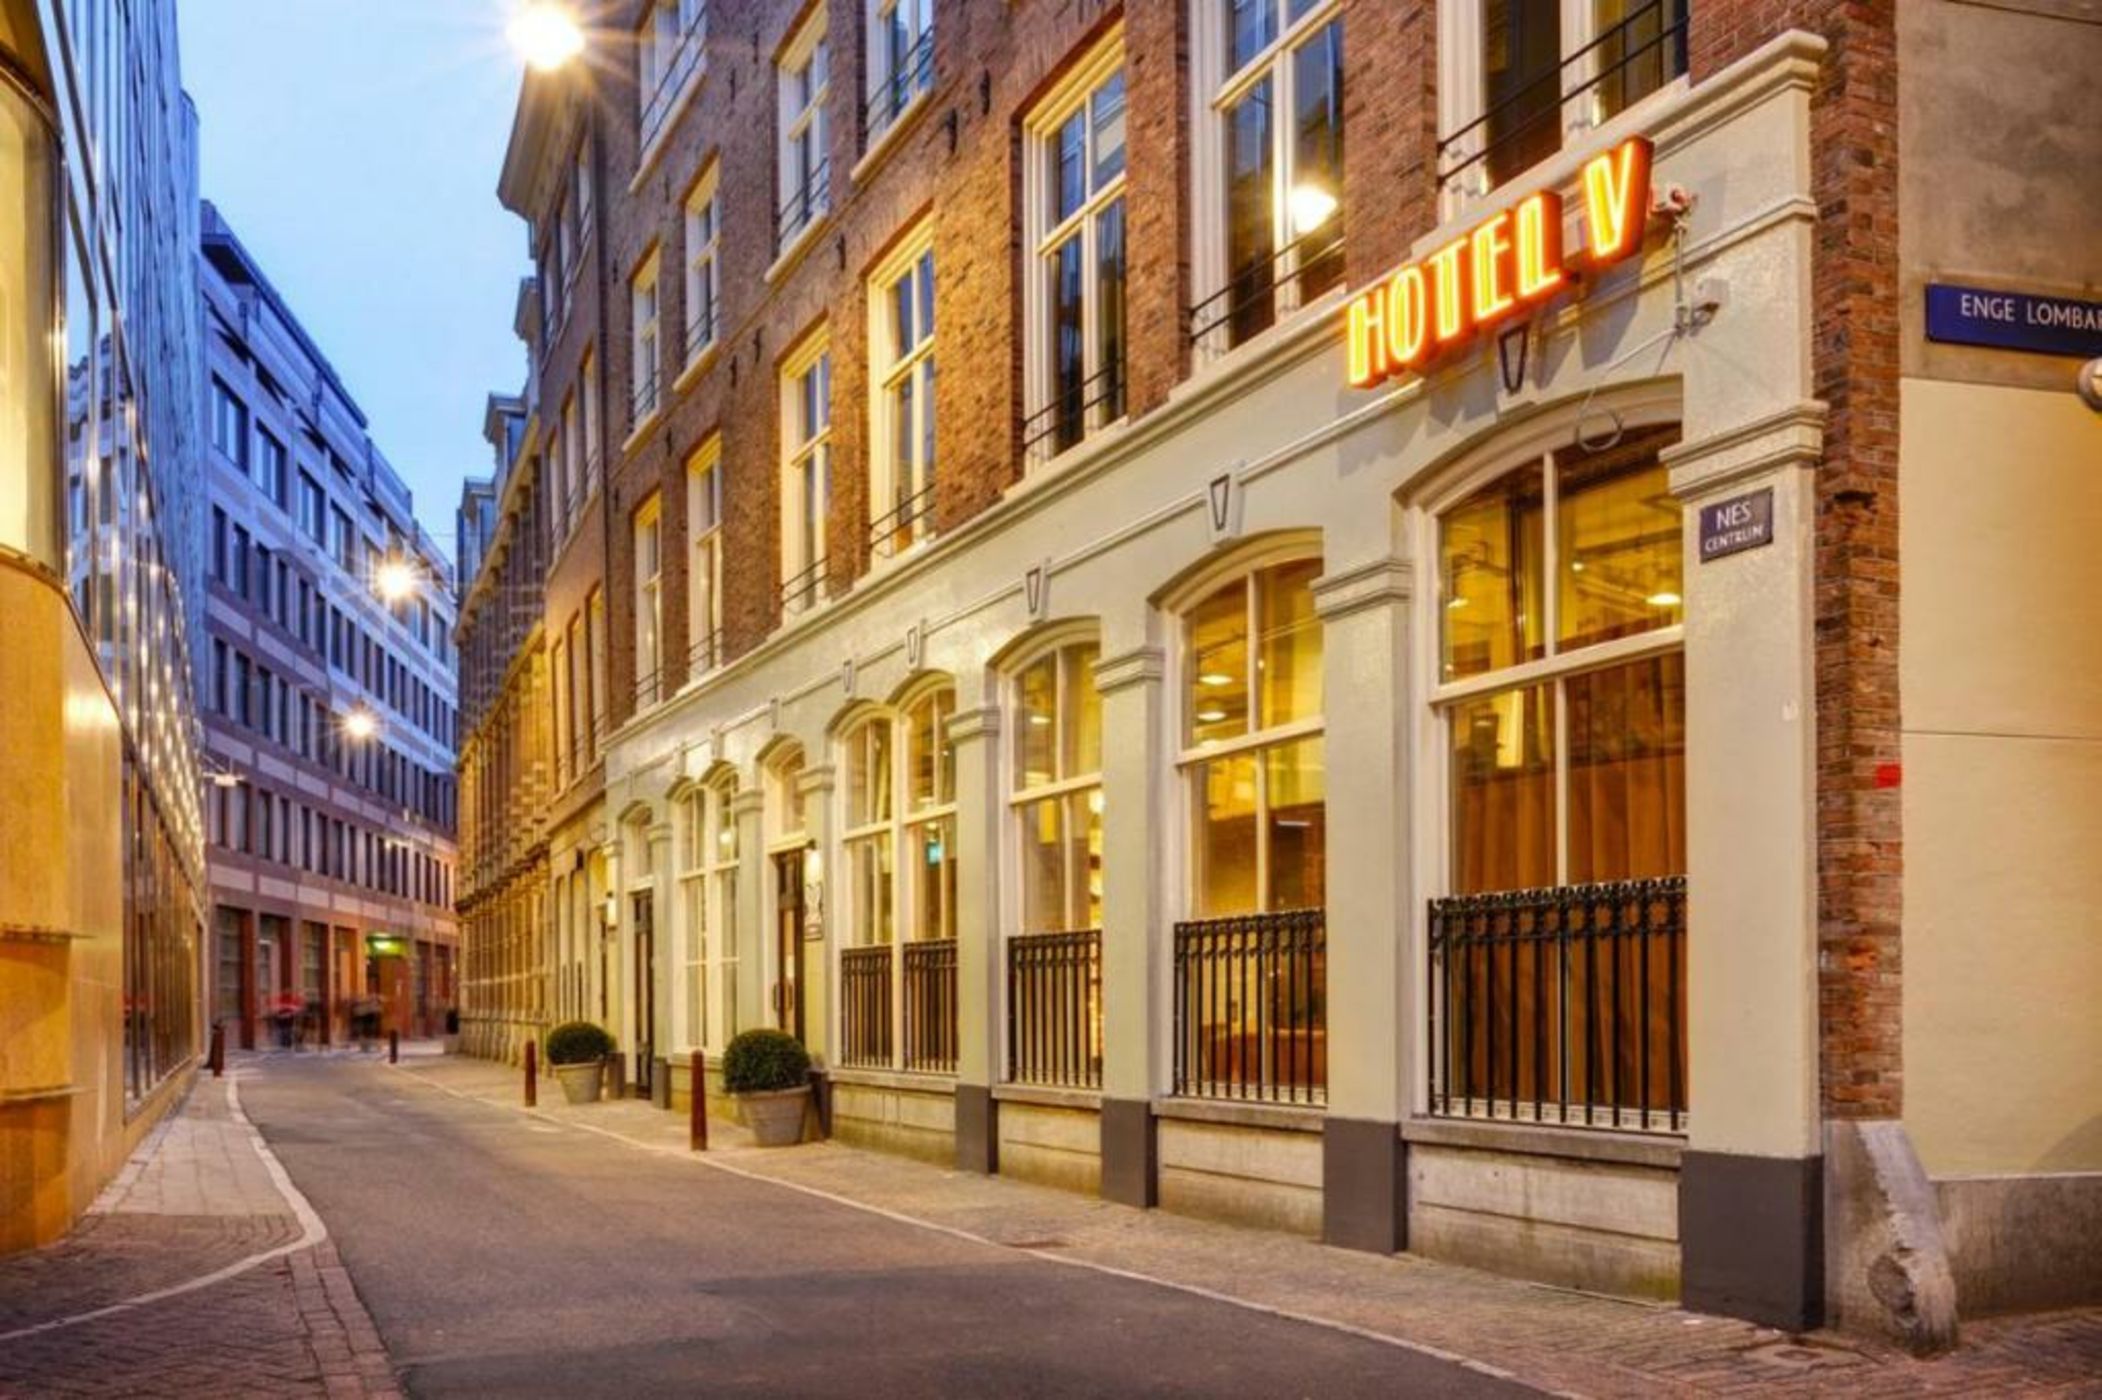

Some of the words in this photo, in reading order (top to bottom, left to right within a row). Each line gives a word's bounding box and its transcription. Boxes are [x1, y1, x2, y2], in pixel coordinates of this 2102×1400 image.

[1348, 190, 1564, 386] HOTEL
[1581, 136, 1646, 266] V
[1960, 294, 2015, 321] ENGE
[1716, 501, 1752, 530] NES
[1704, 524, 1764, 552] CENTRUM
